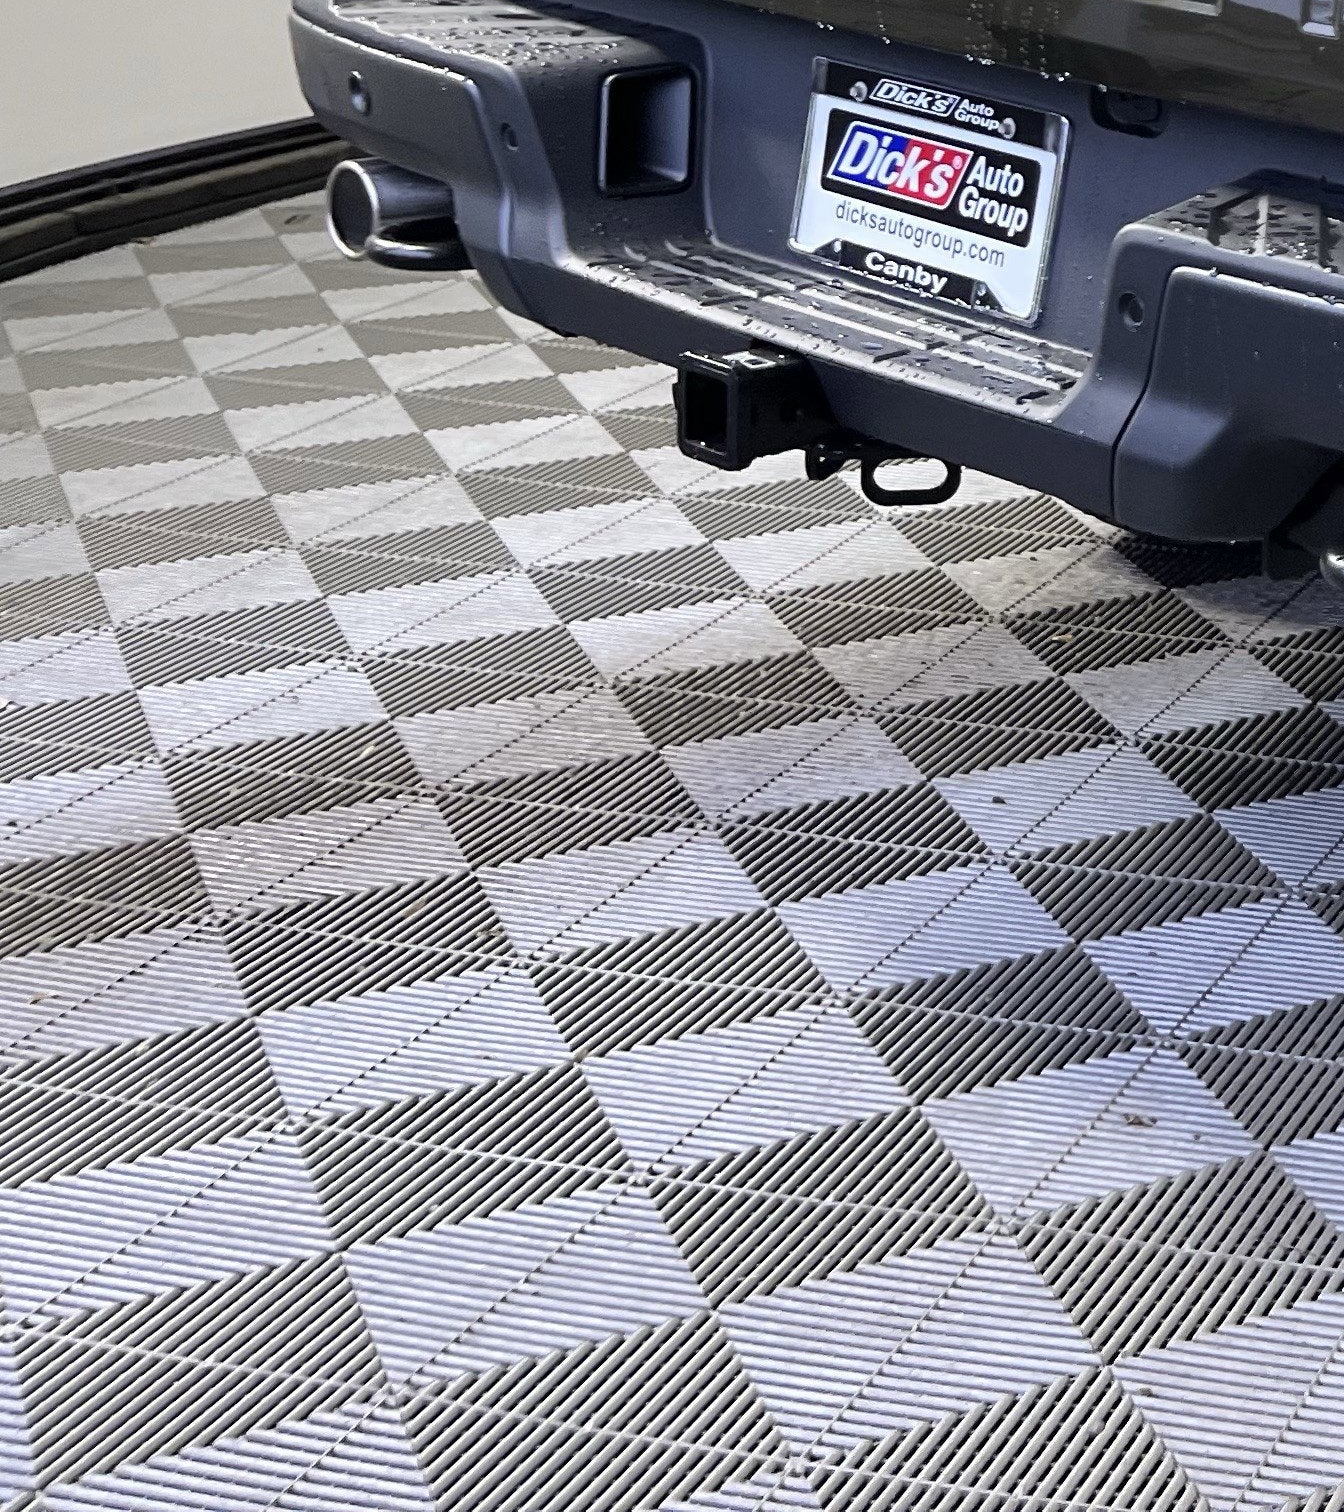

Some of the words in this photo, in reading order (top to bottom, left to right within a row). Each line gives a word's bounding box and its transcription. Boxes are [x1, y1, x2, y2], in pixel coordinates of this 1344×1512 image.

[876, 81, 951, 113] Dick's
[958, 98, 995, 117] Auto
[953, 109, 1001, 131] Group
[836, 130, 955, 199] Dick's
[966, 155, 1025, 198] Auto
[958, 185, 1030, 237] Group
[836, 199, 1006, 268] dicksautogroup.com
[864, 251, 949, 294] Canby
